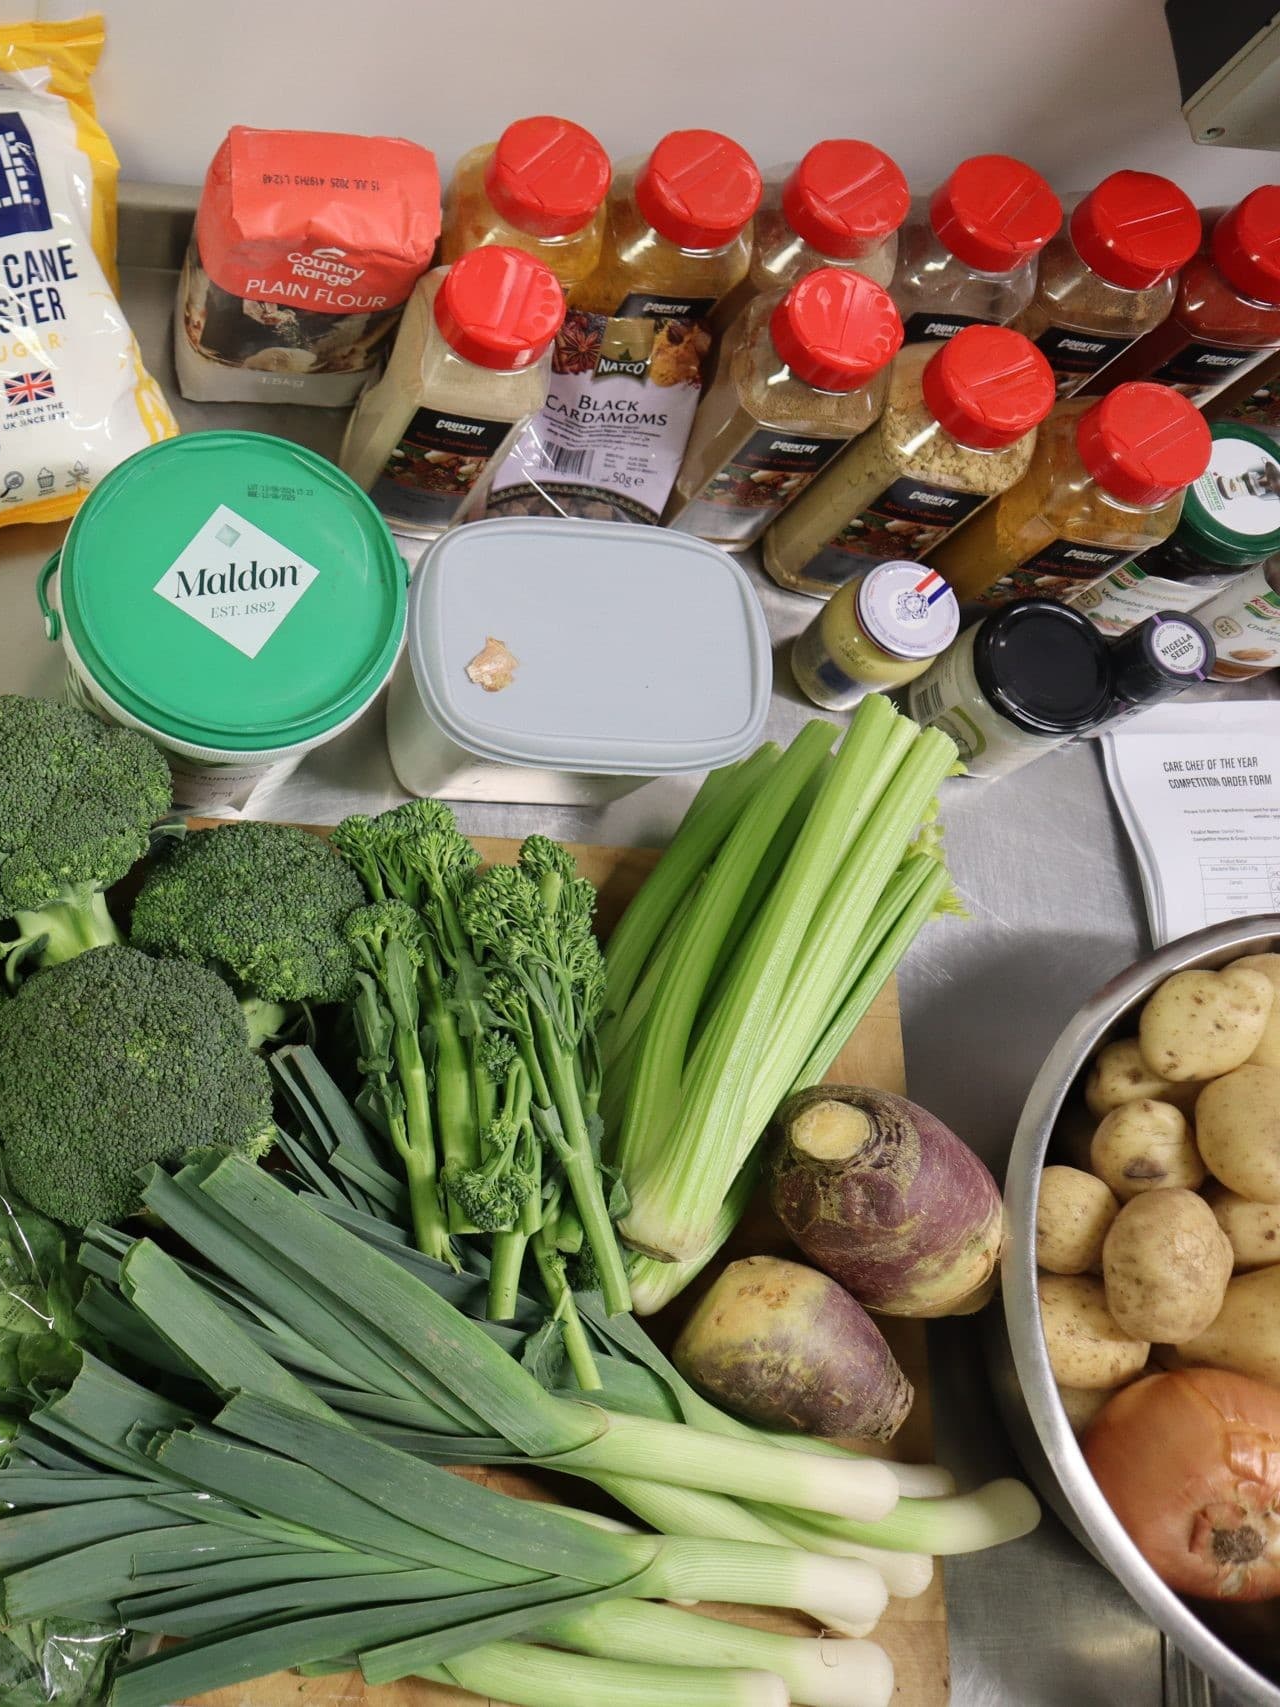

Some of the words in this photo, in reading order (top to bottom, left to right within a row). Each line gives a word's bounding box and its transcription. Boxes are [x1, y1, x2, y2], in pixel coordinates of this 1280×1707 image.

[2, 245, 78, 289] CANE
[287, 252, 365, 280] Country
[292, 263, 353, 287] Range
[245, 279, 309, 299] PLAIN
[314, 288, 387, 308] FLOUR
[598, 358, 648, 376] NATCO
[6, 408, 32, 420] MADE
[34, 406, 44, 414] IN
[46, 401, 64, 411] THE
[545, 394, 669, 428] CARDAMOMS
[578, 395, 640, 413] BLACK
[3, 422, 17, 430] UK
[435, 419, 486, 436] COUNTRY
[769, 440, 821, 454] COUNTRY
[612, 472, 632, 488] 50g
[909, 491, 960, 508] COUNTRY
[173, 560, 299, 600] Maldon
[210, 604, 242, 620] EST.
[244, 600, 276, 615] 1882
[1160, 633, 1193, 656] NIGELLA
[1170, 642, 1194, 661] SEEDS
[1163, 761, 1184, 773] CARE
[1185, 759, 1206, 772] CHEF
[1207, 758, 1218, 770] OF
[1220, 757, 1236, 769] THE
[1237, 756, 1259, 769] YEAR
[1168, 777, 1221, 790] COMPETITION
[1222, 775, 1249, 788] ORDER
[1249, 774, 1273, 786] FORM
